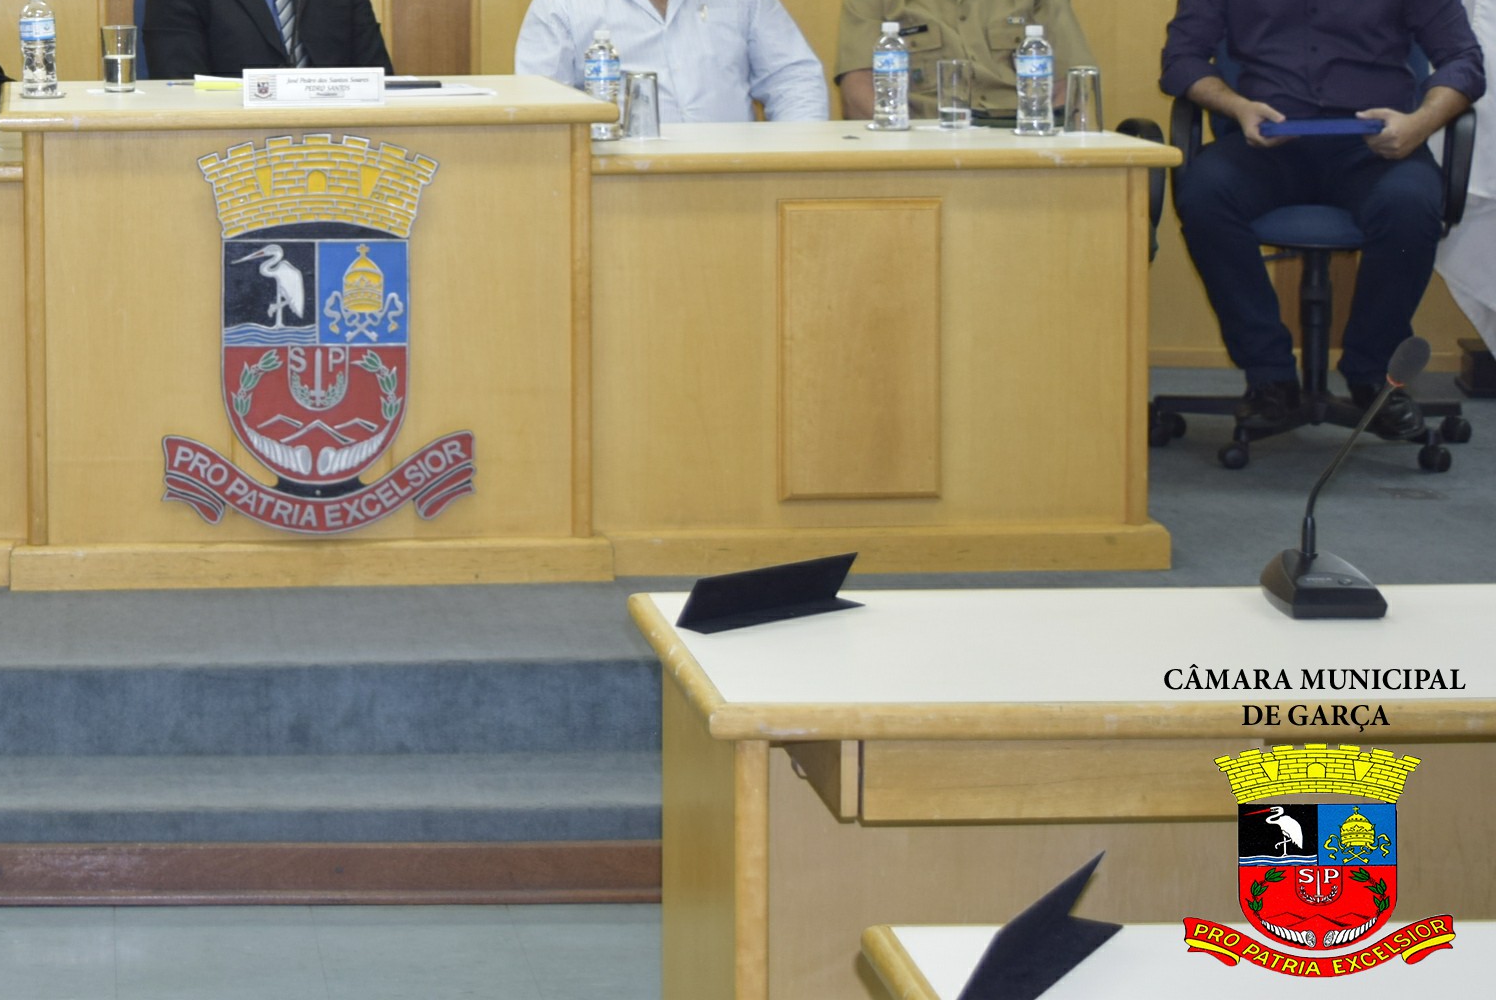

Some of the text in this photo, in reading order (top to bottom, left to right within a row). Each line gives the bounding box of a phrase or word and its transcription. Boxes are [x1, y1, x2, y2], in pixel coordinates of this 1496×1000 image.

[172, 440, 468, 527] PRO PATRIA EXCELSIOR
